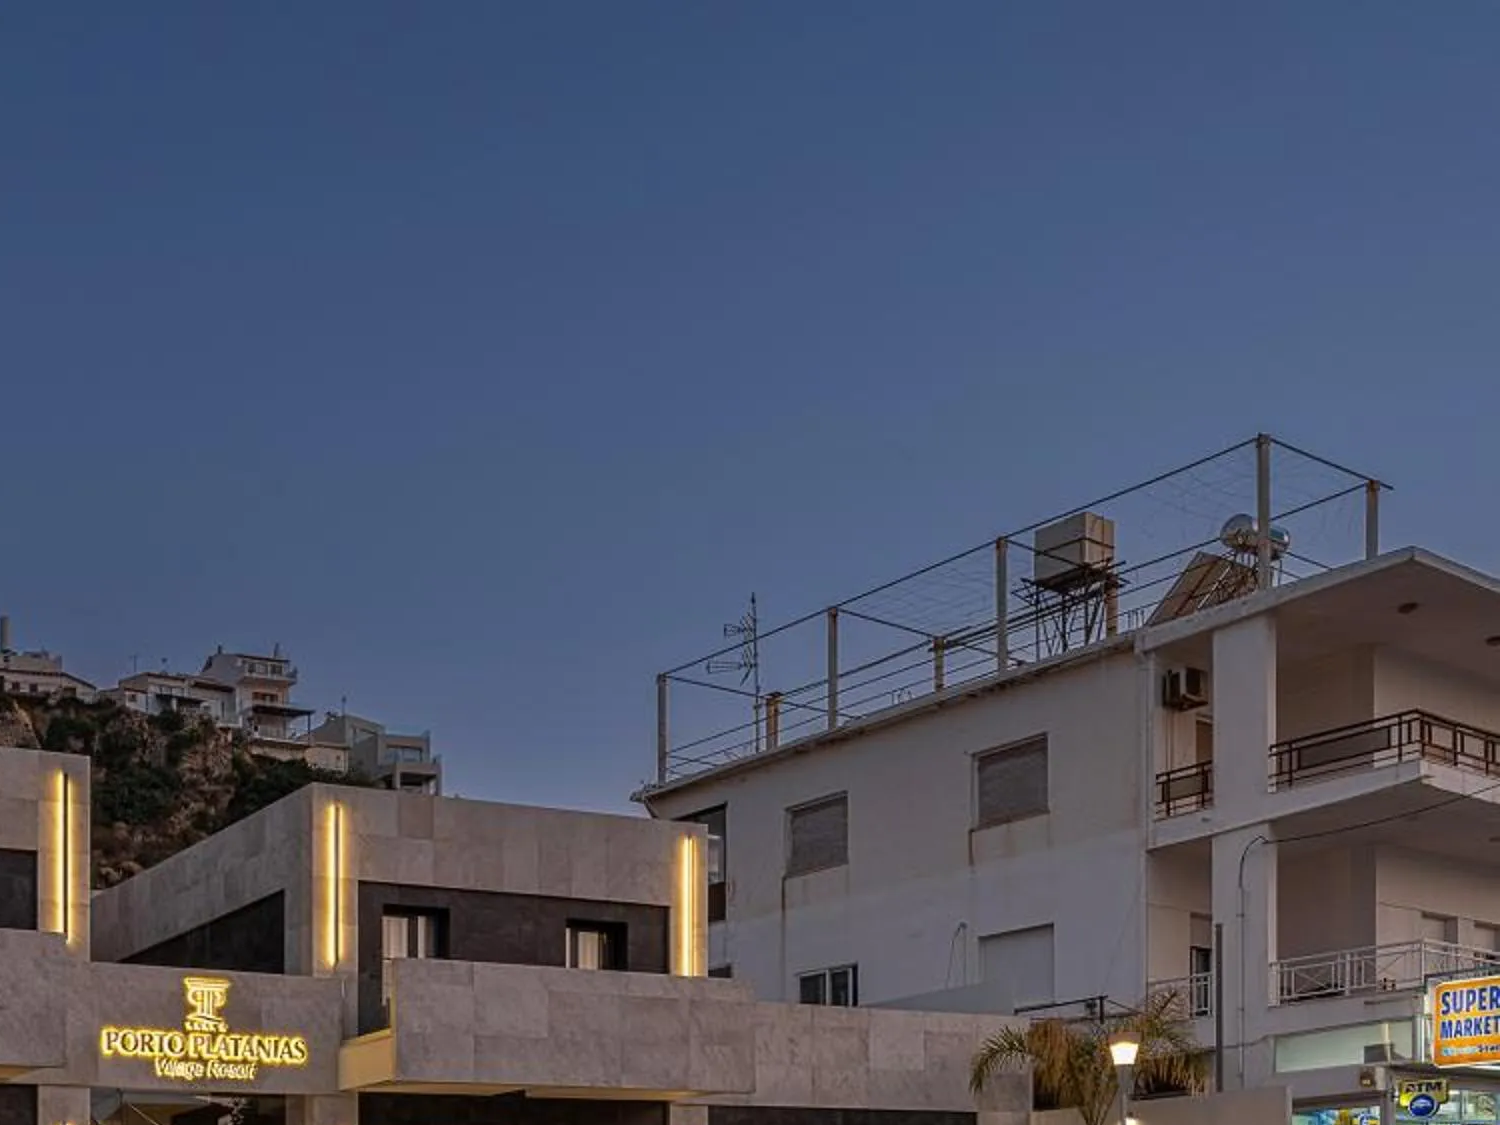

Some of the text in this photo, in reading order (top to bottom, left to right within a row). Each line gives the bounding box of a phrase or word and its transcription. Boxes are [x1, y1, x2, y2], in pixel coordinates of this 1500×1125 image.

[1441, 986, 1500, 1015] SUPER
[1441, 1015, 1500, 1038] MARKET
[103, 1029, 306, 1061] PORTO PLATANIAS
[156, 1057, 257, 1080] Village Resort
[1405, 1082, 1442, 1092] ATM
